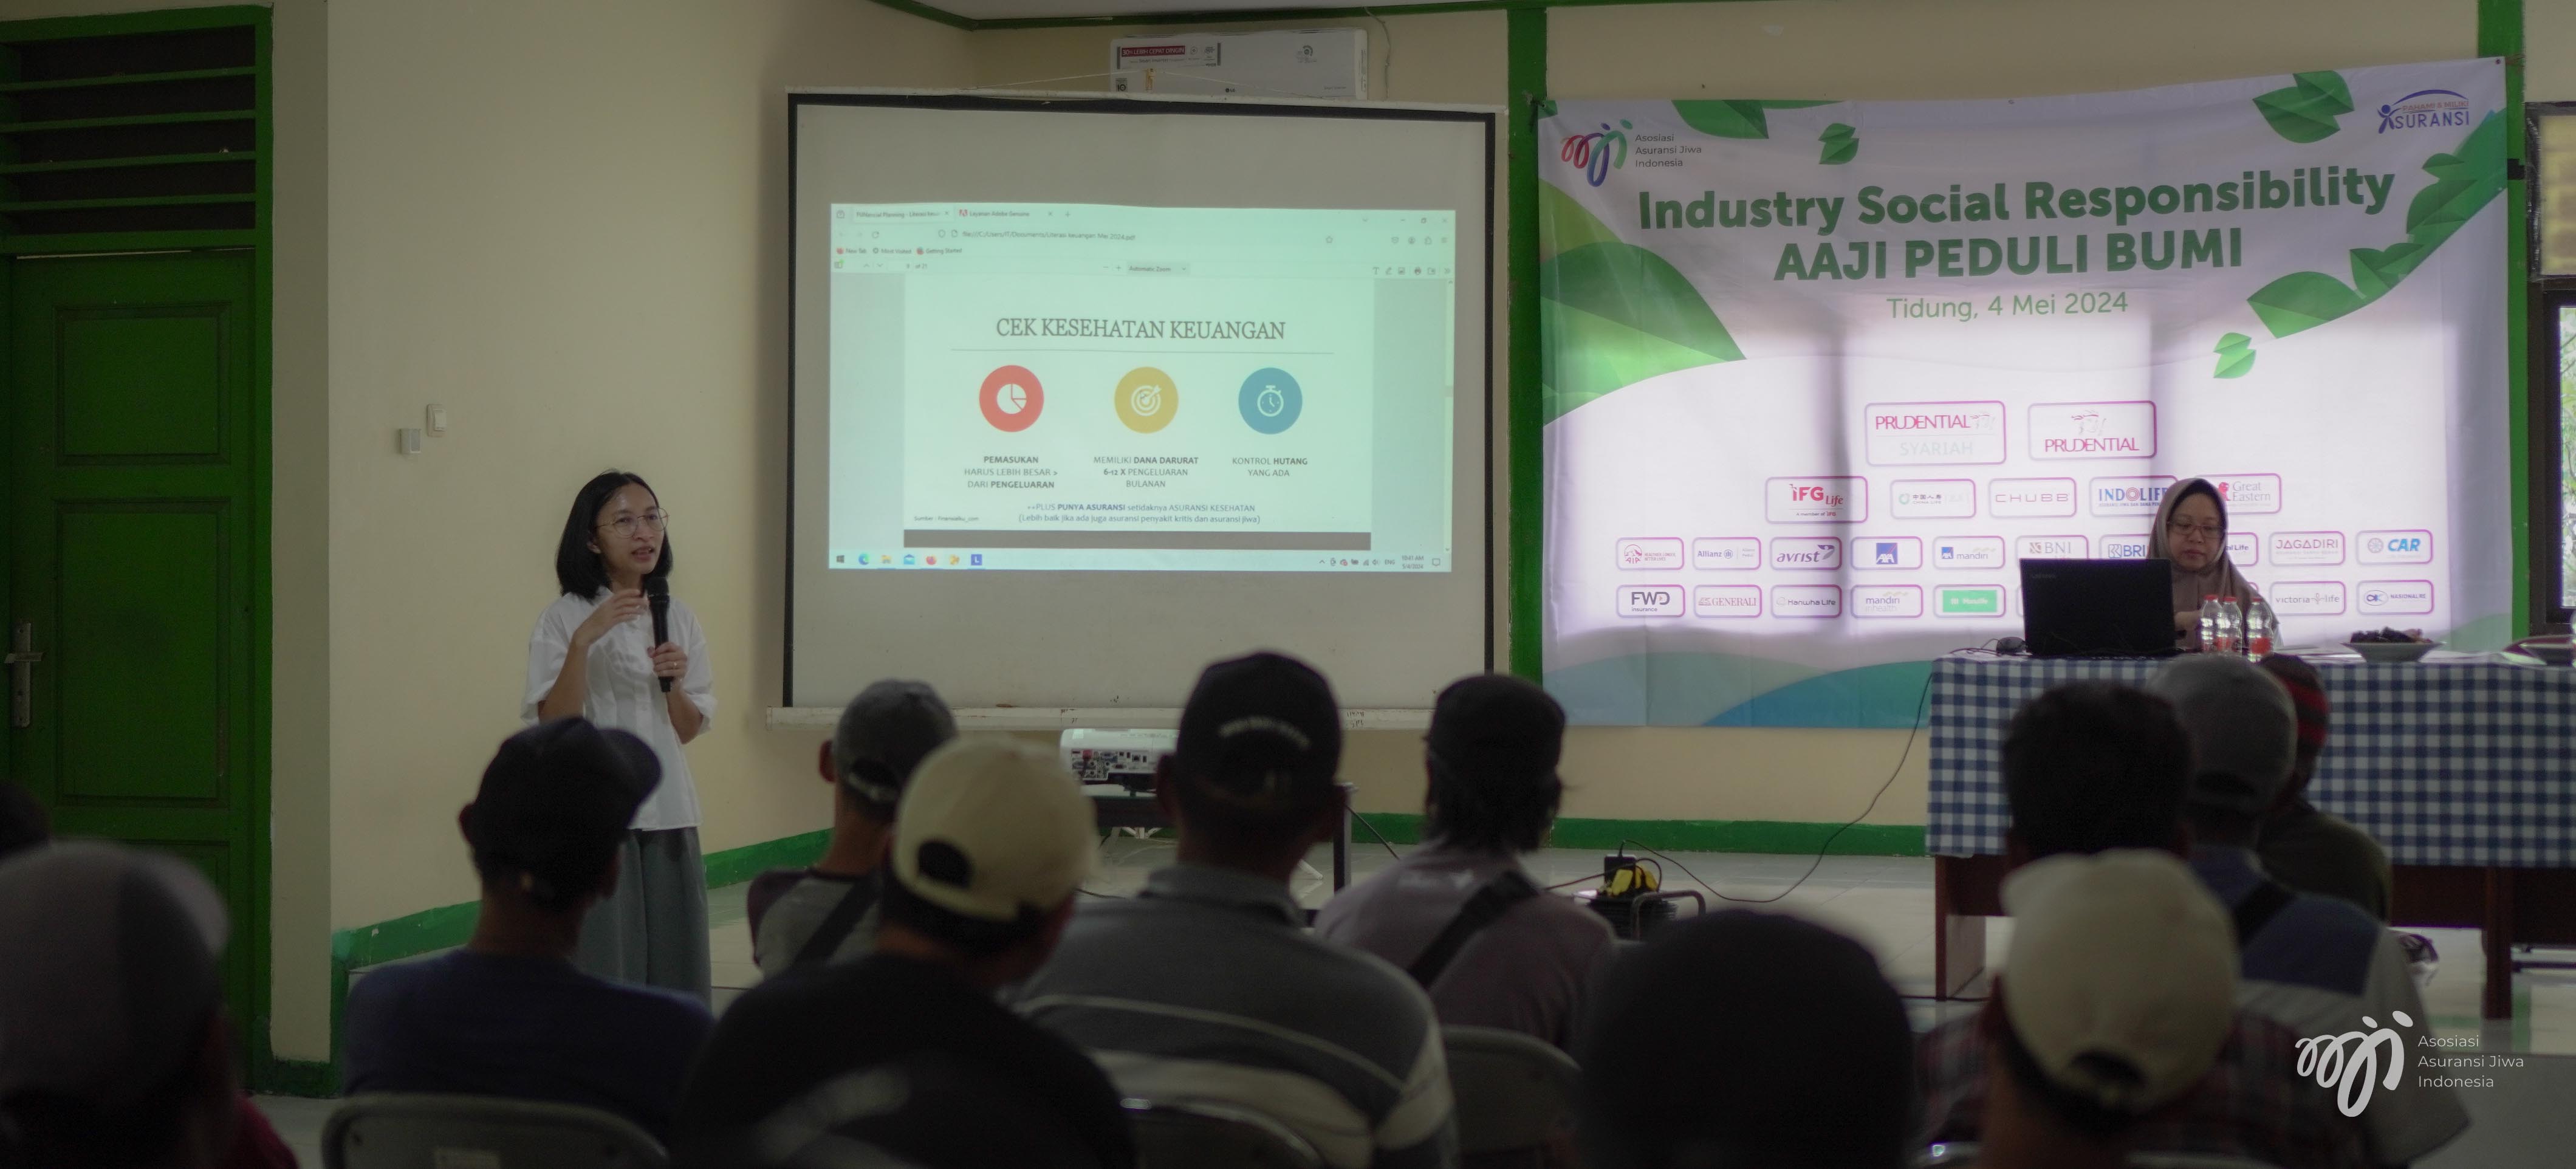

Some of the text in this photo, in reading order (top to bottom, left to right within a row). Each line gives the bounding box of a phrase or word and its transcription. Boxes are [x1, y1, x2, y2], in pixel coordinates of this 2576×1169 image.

[1635, 133, 1674, 142] Asosiasi
[1635, 145, 1702, 155] Asuransi Jiwa
[1636, 158, 1683, 167] Indonesia
[1639, 166, 2396, 236] Industry Social Responsibility
[1773, 227, 2242, 281] AAJI PEDULI BUMI
[1886, 291, 2128, 323] Tidung, 4 Mei 2024
[996, 318, 1286, 340] CEK KESEHATAN KEUANGAN
[1875, 414, 1971, 430] PRUDENTIAL
[1900, 442, 1973, 457] SYARIAH
[2044, 437, 2140, 453] PRUDENTIAL
[1273, 457, 1308, 465] HUTANG
[2233, 481, 2261, 492] Great
[1826, 495, 1843, 507] Life
[1995, 493, 2069, 503] CHUBB
[2233, 492, 2270, 502] Eastern
[1128, 504, 1167, 513] setidaknya
[1018, 514, 1043, 524] (Lebih
[1061, 515, 1074, 523] jika
[1091, 515, 1107, 524] juga
[1140, 515, 1173, 524] penyakit
[2045, 542, 2072, 554] BNI
[2276, 539, 2338, 549] JAGADIRI
[2388, 538, 2421, 552] CAR
[1956, 551, 1989, 560] mandiri
[2123, 544, 2145, 557] BRI
[1776, 551, 1821, 563] avrist
[1876, 554, 1895, 563] AXA
[1631, 591, 1670, 606] FWD
[1712, 597, 1756, 606] GENERALI
[2275, 595, 2310, 603] victoria
